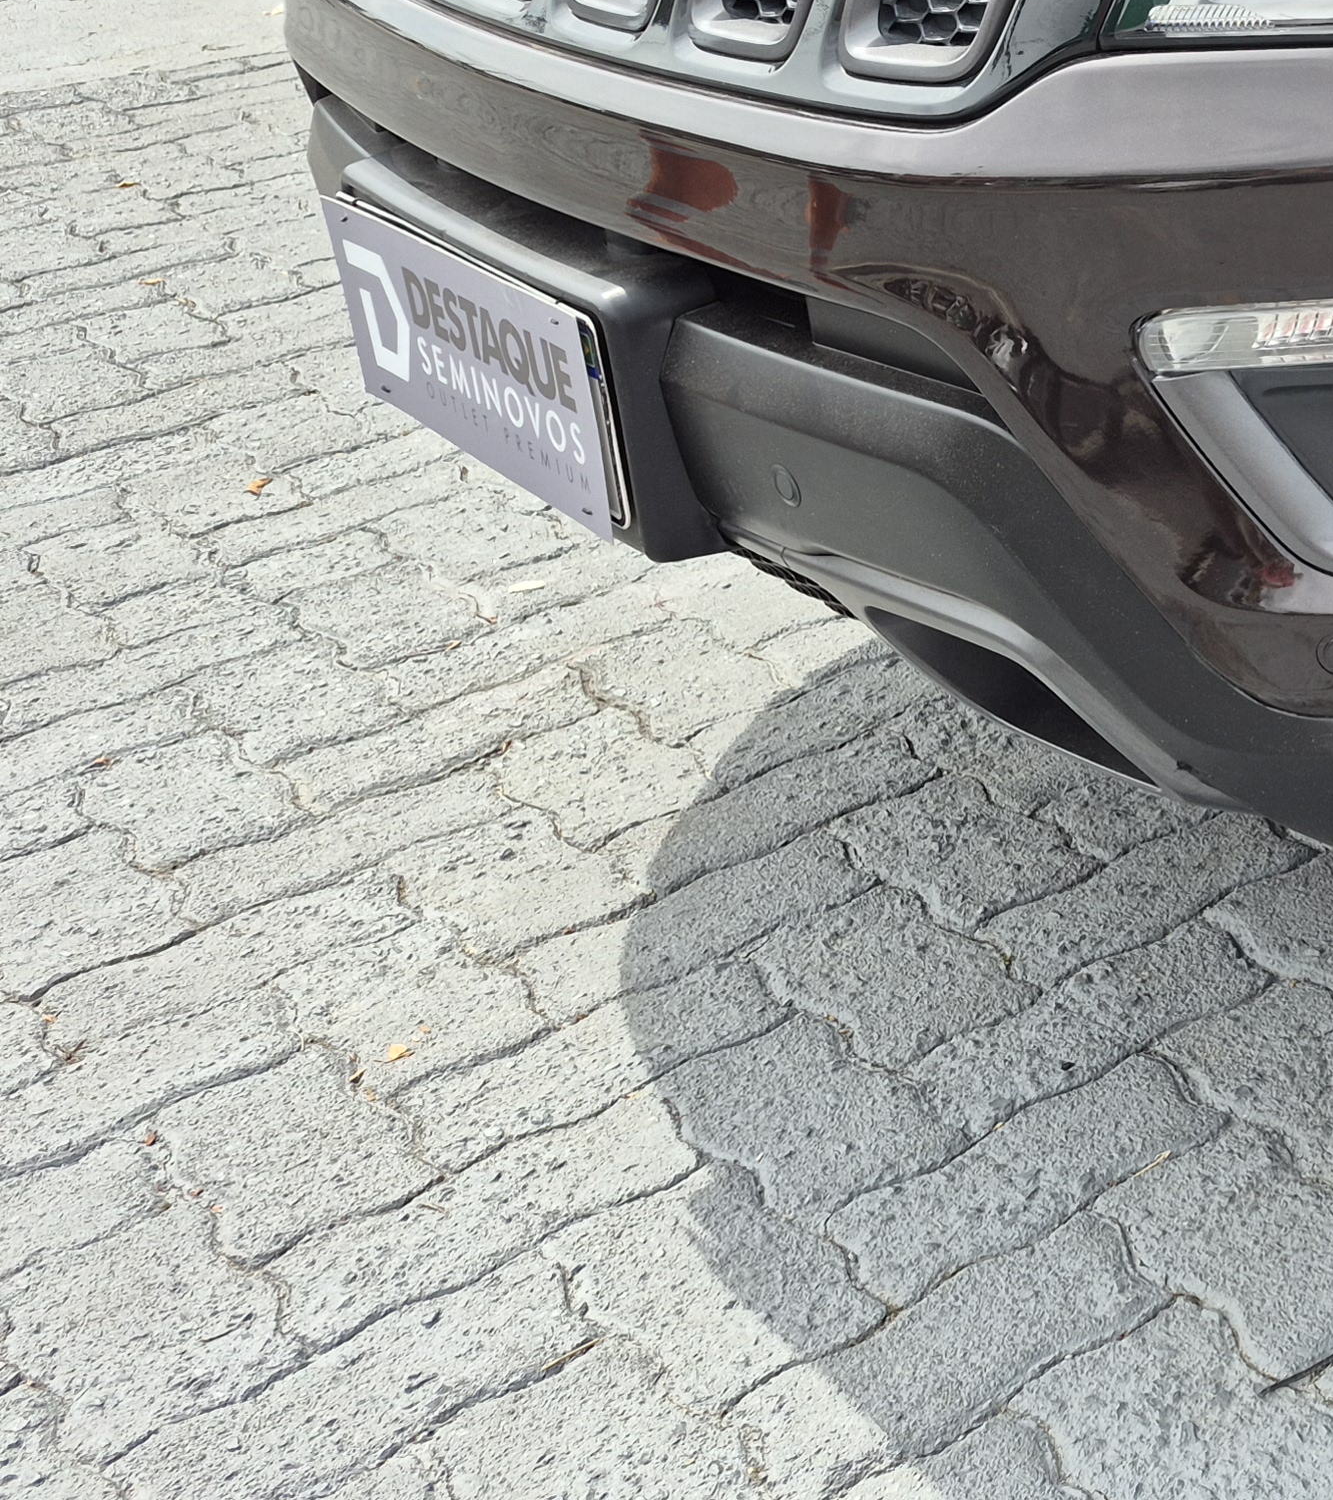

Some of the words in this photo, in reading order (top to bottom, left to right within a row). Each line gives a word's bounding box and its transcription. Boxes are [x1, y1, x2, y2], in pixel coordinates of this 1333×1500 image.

[402, 266, 577, 413] DESTAQUE
[417, 337, 585, 465] SEMINOVOS
[426, 381, 488, 432] OUTLET
[504, 427, 591, 493] PREMIUM
